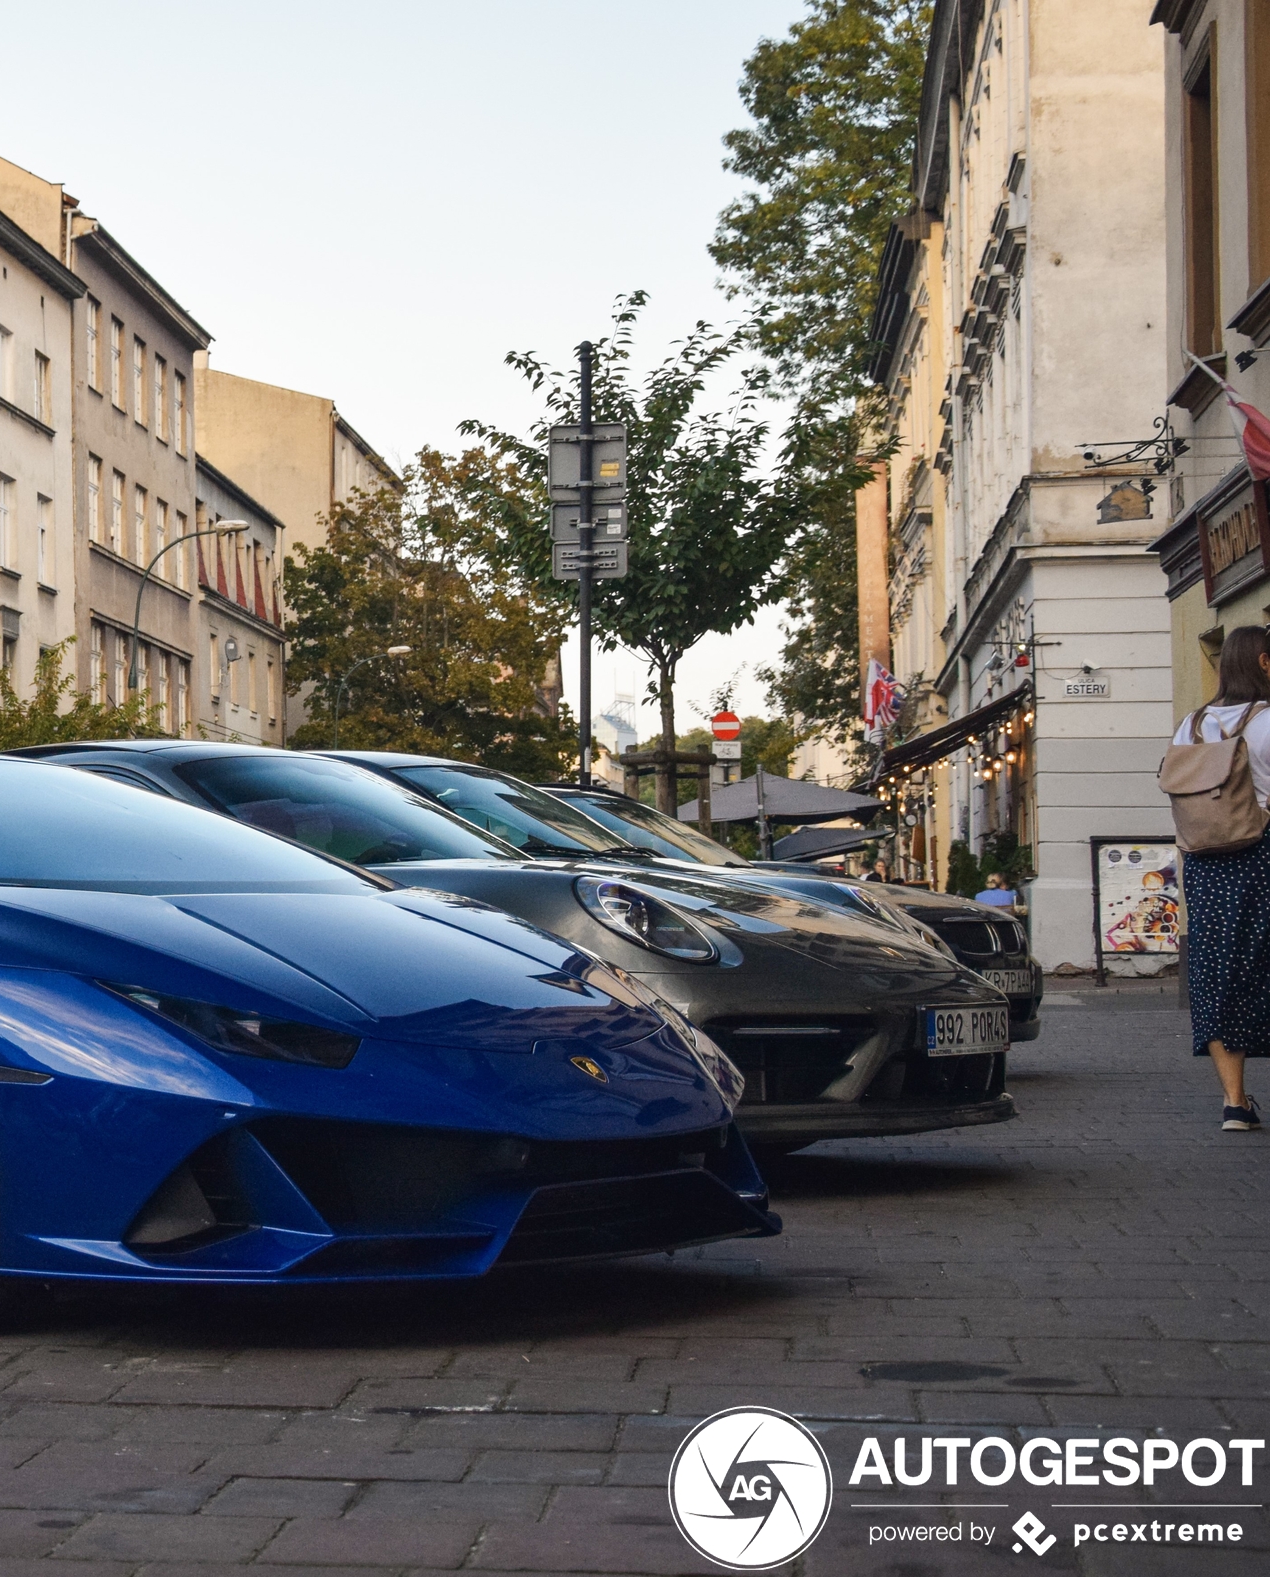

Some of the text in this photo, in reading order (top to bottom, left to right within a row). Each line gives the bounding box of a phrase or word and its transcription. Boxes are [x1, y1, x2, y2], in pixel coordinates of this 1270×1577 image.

[1067, 684, 1106, 694] ESTERY
[936, 1010, 1007, 1045] 992 POR4S
[926, 1036, 935, 1045] CZ
